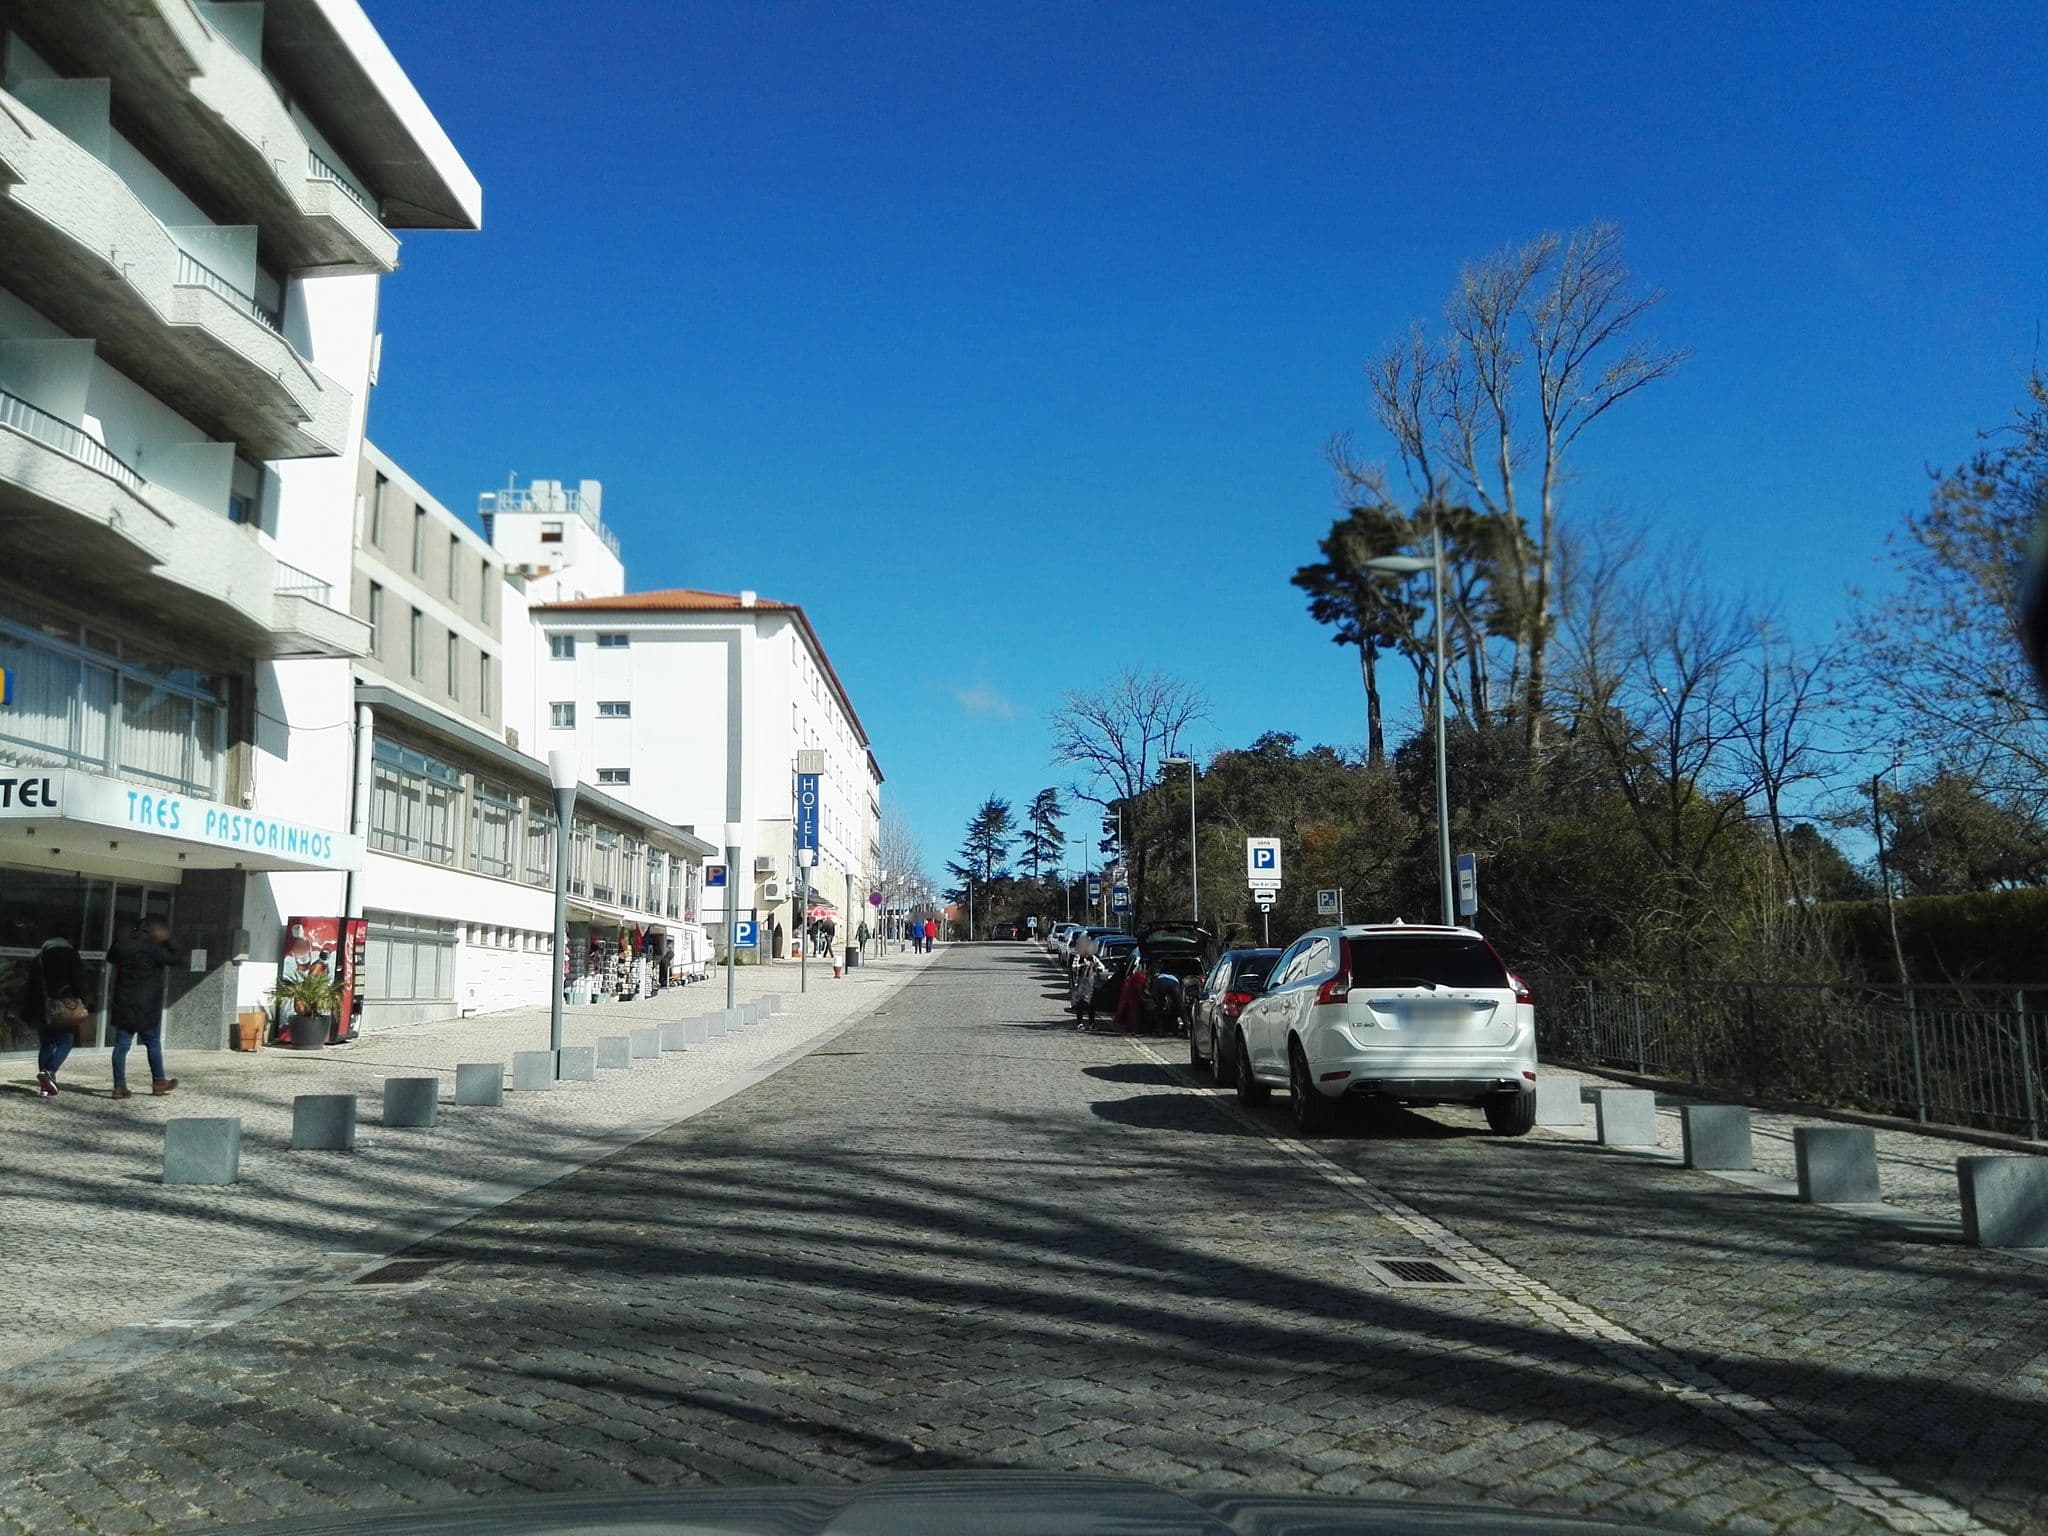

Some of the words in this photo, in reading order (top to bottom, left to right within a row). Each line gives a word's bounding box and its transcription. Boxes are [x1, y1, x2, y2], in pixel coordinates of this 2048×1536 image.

[802, 778, 815, 849] HOTEL
[205, 809, 331, 859] PASTORINHOS
[1257, 850, 1271, 868] P
[708, 867, 724, 881] P
[736, 922, 751, 943] P
